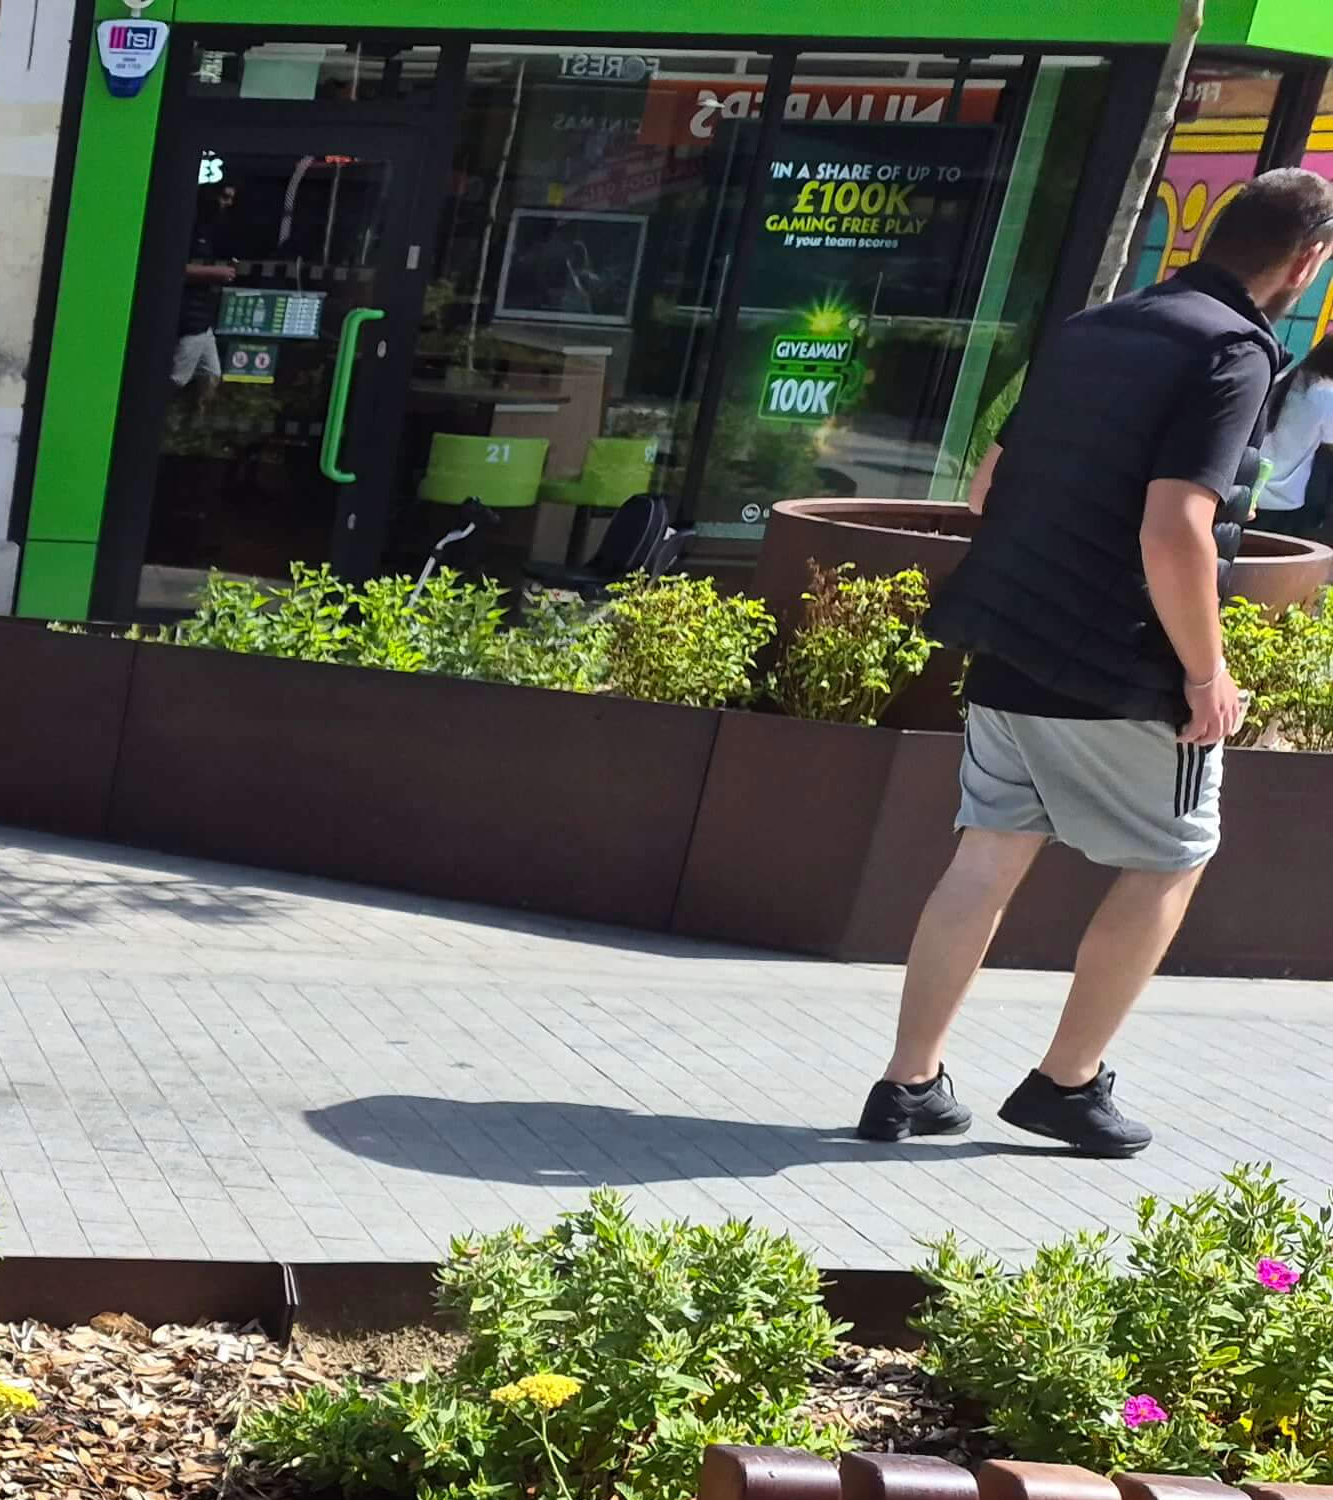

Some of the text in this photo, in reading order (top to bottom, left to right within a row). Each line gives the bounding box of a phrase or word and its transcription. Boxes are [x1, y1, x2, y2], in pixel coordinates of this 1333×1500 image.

[770, 162, 961, 182] IN A SHARE OF UP TO
[792, 181, 917, 215] £100K
[765, 215, 928, 235] GAMING FREE PLAY
[796, 236, 823, 248] your
[825, 235, 856, 248] team
[858, 238, 898, 248] scores
[776, 341, 848, 360] GIVEAWAY
[769, 378, 837, 414] 100K
